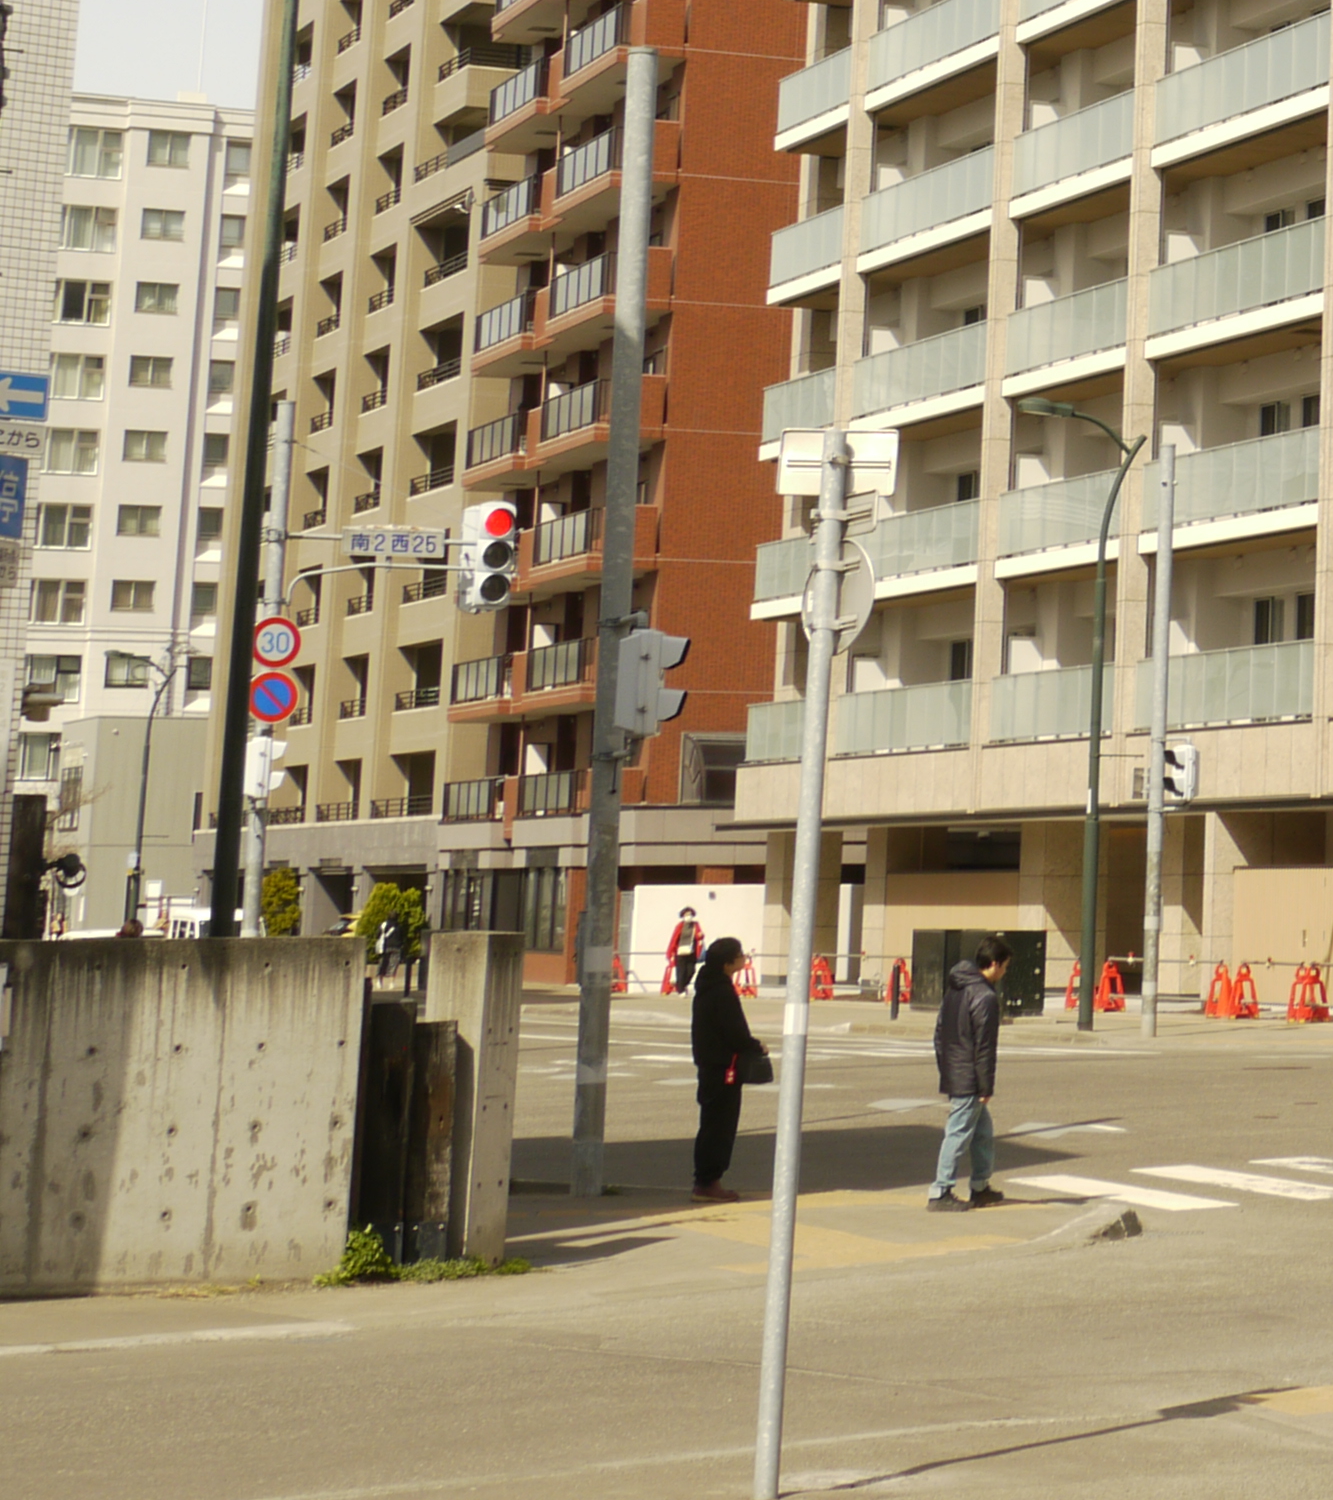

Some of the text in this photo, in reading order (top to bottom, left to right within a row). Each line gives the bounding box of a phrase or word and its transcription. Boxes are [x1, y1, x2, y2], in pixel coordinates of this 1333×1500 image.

[0, 429, 40, 448] から
[351, 533, 437, 553] 南2西25
[261, 632, 290, 654] 30
